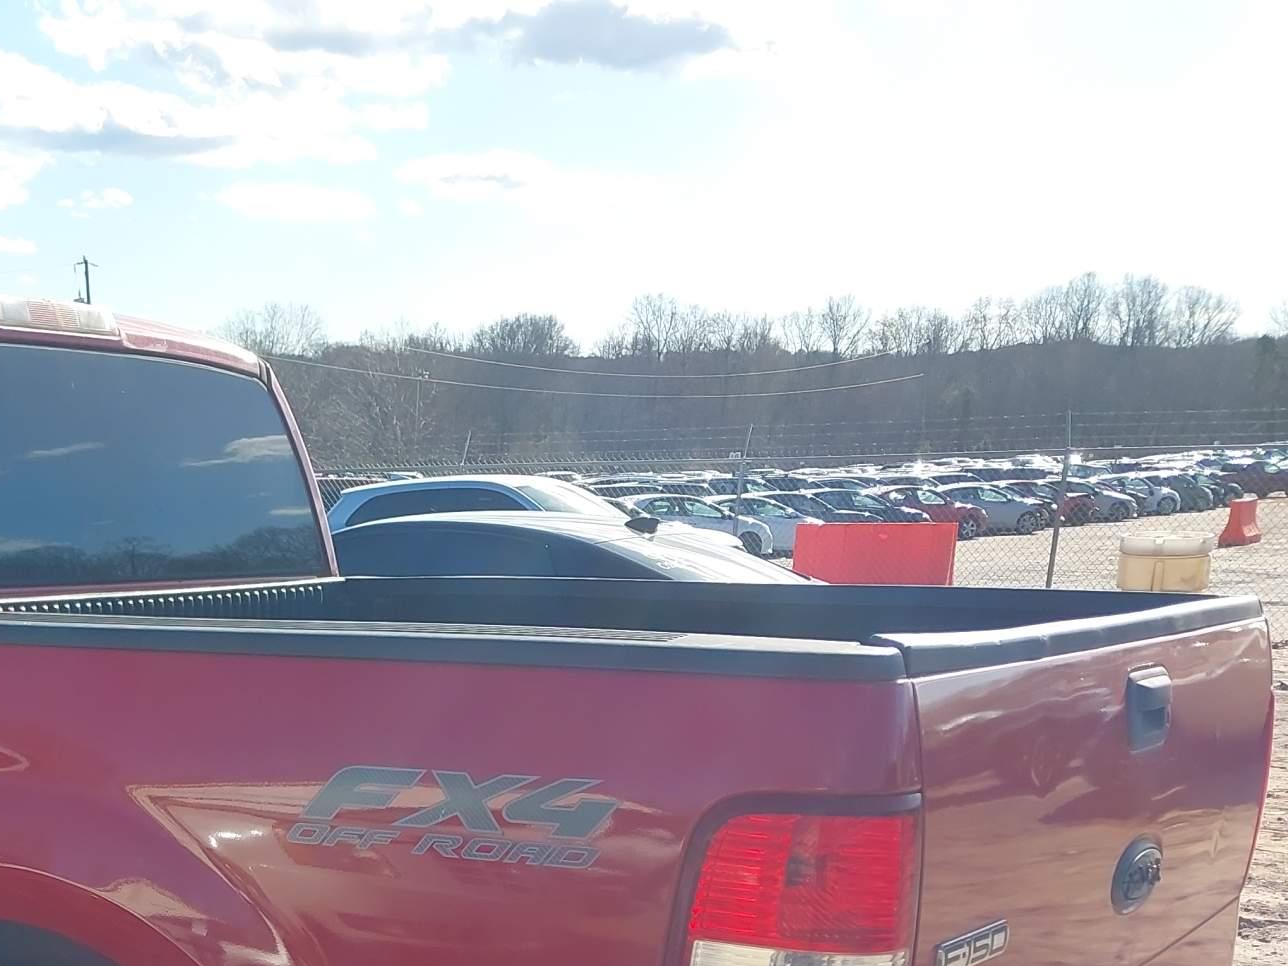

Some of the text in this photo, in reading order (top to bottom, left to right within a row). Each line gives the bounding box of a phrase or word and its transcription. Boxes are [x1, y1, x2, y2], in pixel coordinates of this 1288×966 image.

[299, 765, 618, 840] FX4
[286, 822, 601, 869] OFF ROAD
